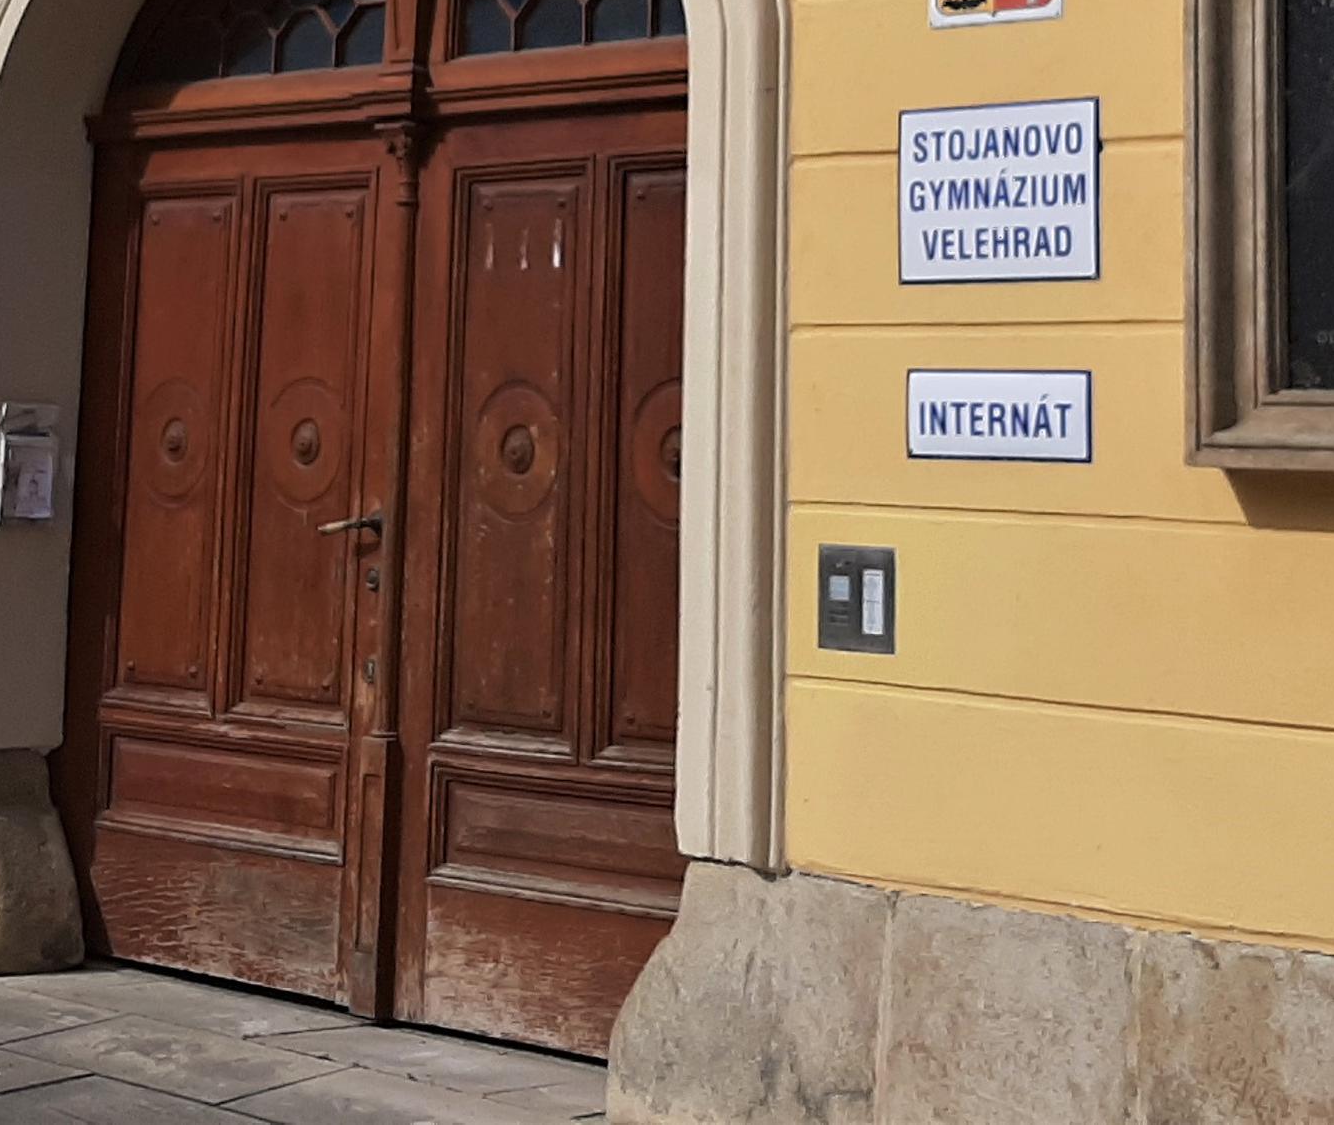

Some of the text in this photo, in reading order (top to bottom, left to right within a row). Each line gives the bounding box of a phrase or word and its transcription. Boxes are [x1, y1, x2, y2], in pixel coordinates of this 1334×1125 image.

[912, 122, 1084, 164] STOJANOVO
[908, 169, 1087, 212] GYMNÁZIUM
[922, 225, 1073, 261] VELEHRAD
[918, 394, 1073, 439] INTERNÁT
